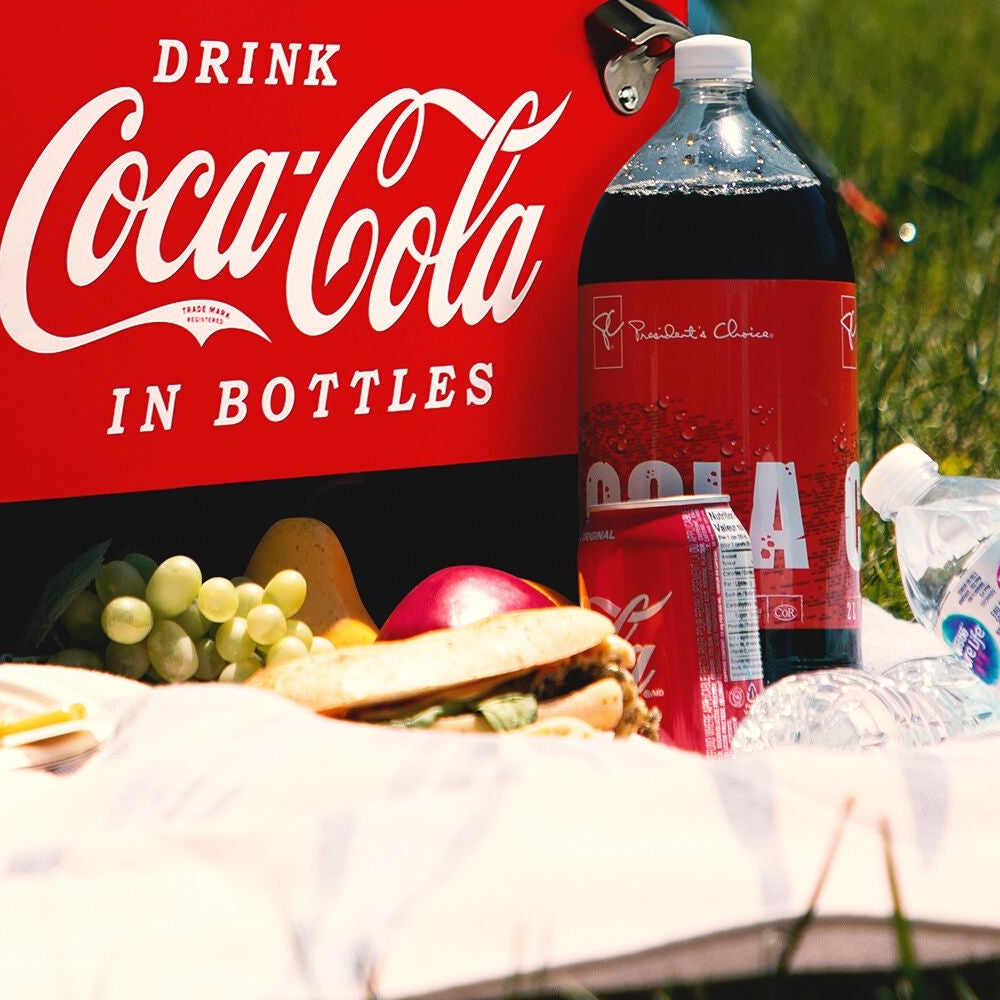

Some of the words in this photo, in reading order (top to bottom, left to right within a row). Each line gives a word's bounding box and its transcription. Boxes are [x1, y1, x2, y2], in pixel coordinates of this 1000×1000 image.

[153, 38, 341, 87] DRINK
[182, 305, 206, 314] TRADE
[209, 306, 231, 319] MARK
[187, 316, 224, 325] REGISTERED
[628, 319, 707, 342] President's
[107, 383, 181, 434] IN
[213, 362, 495, 427] BOTTLES
